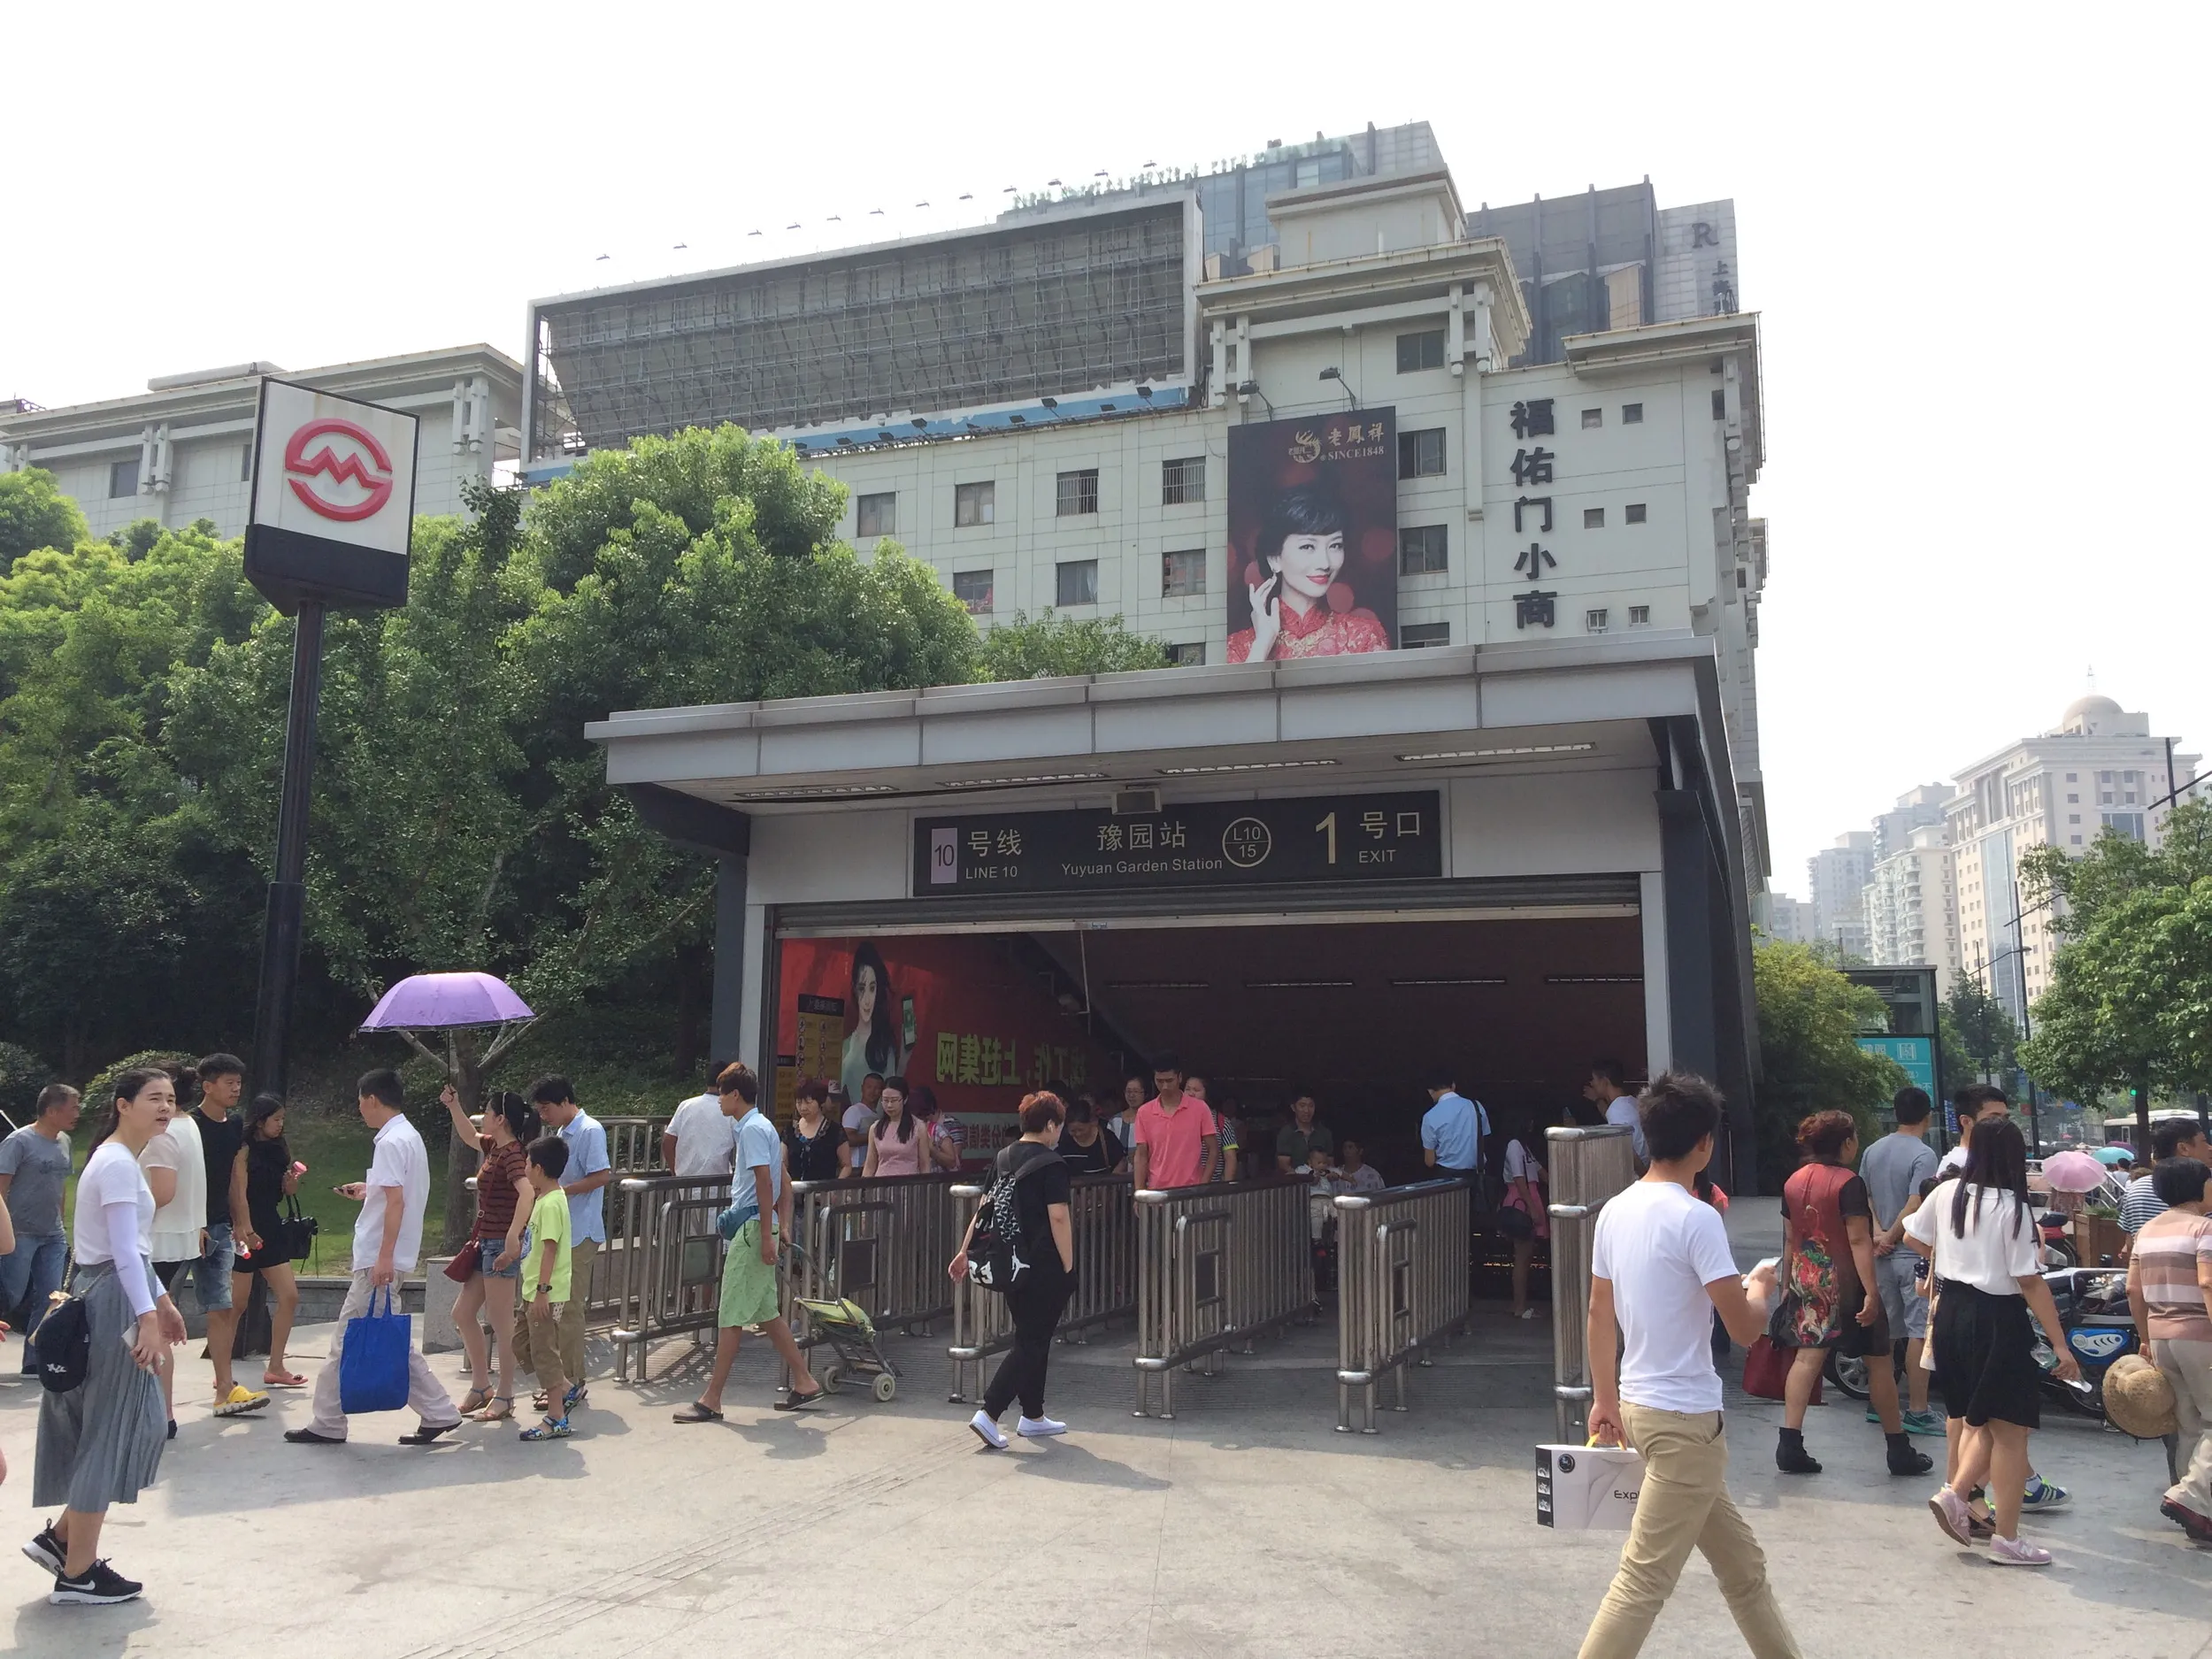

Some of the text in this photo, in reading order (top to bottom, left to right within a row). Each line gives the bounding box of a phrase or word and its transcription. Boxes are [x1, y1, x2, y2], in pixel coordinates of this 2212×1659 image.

[1509, 399, 1557, 629] 福佑门小商
[1097, 820, 1187, 851] 豫园站
[1233, 826, 1261, 841] L10
[1316, 811, 1420, 864] 1 号口
[934, 829, 1022, 866] 10 号线
[1239, 844, 1256, 857] 15
[1359, 849, 1396, 863] EXIT
[965, 865, 1018, 879] LINE 10
[1062, 857, 1223, 877] Yuyuan Garden Station
